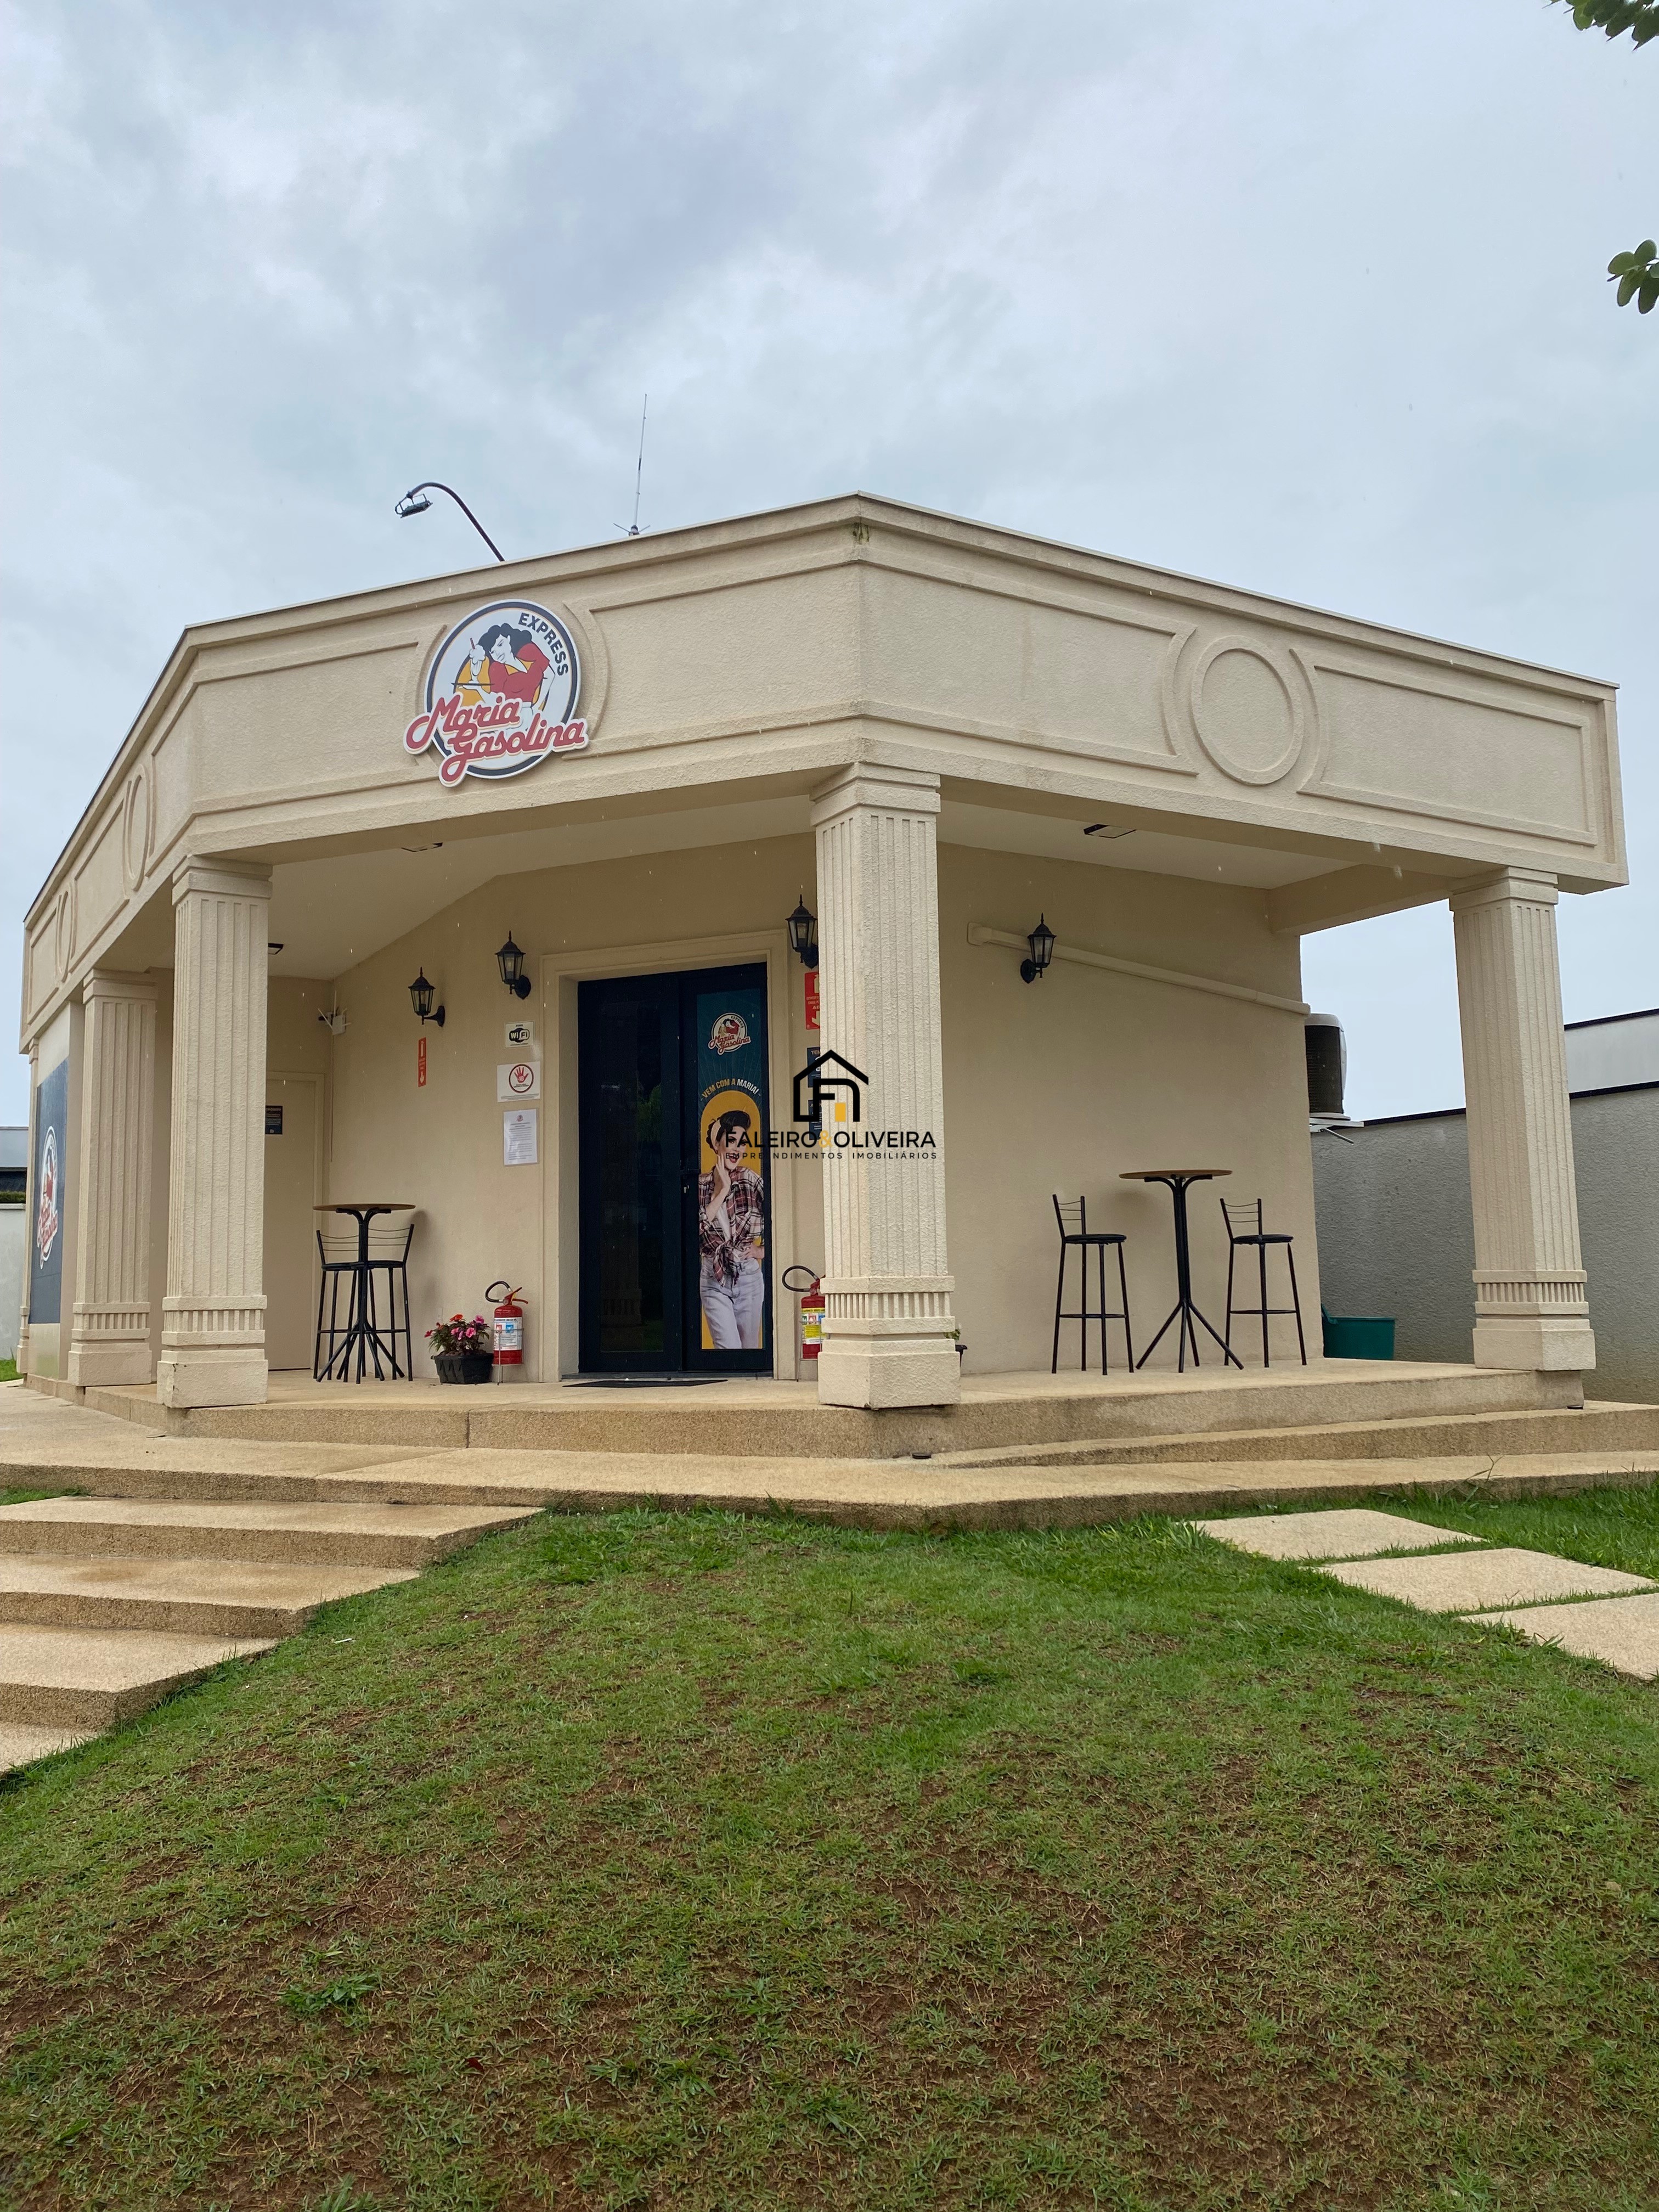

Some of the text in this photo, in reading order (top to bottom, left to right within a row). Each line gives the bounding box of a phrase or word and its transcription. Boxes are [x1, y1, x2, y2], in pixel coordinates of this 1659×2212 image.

[517, 612, 569, 677] EXPRESS
[405, 695, 521, 750] Maria
[441, 713, 585, 783] Gasolina
[709, 1035, 735, 1048] Maria
[719, 1037, 750, 1053] Gasolina
[702, 1084, 716, 1098] VEM
[715, 1078, 730, 1089] COM
